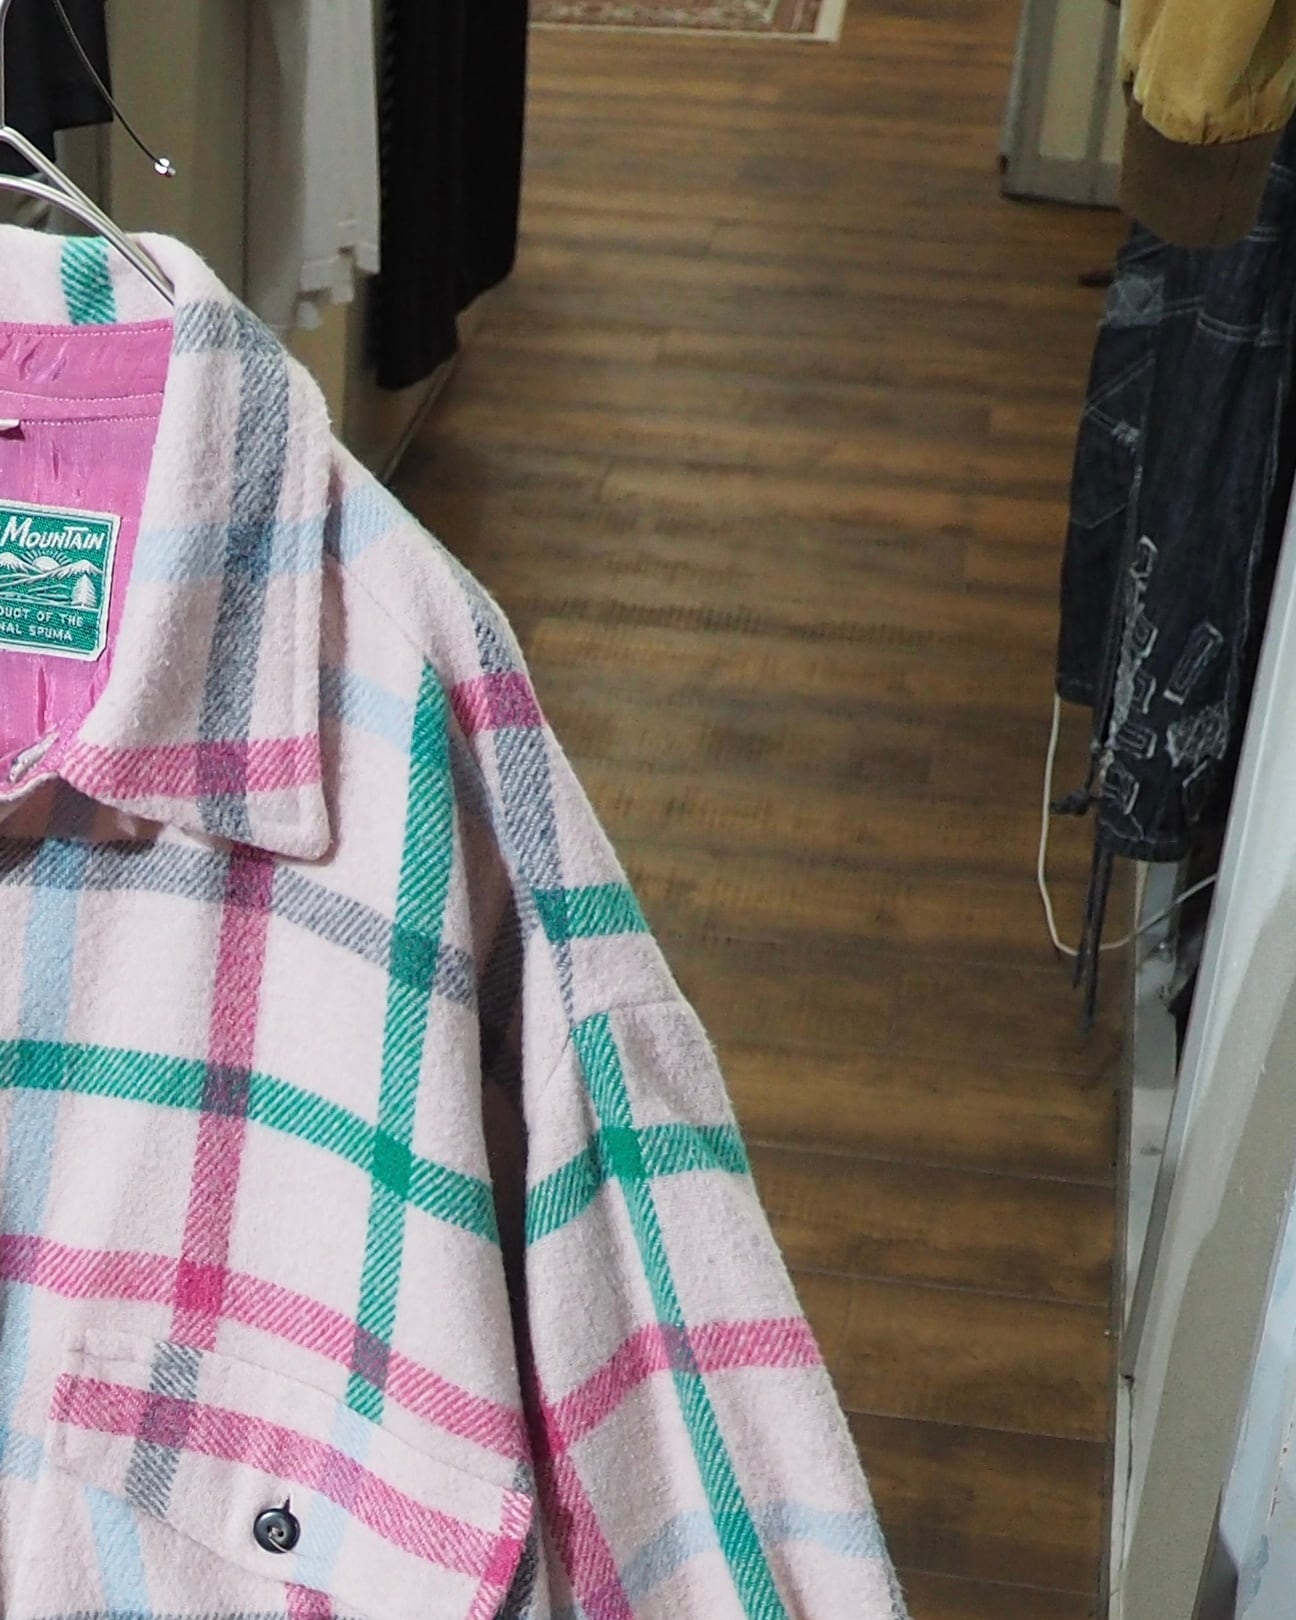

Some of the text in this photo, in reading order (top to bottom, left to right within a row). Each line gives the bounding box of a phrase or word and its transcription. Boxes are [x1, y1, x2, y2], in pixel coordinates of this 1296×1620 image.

[0, 516, 105, 550] MOUNTAIN
[37, 611, 53, 623] OF
[61, 613, 84, 627] THE
[29, 625, 73, 641] SPUMA
